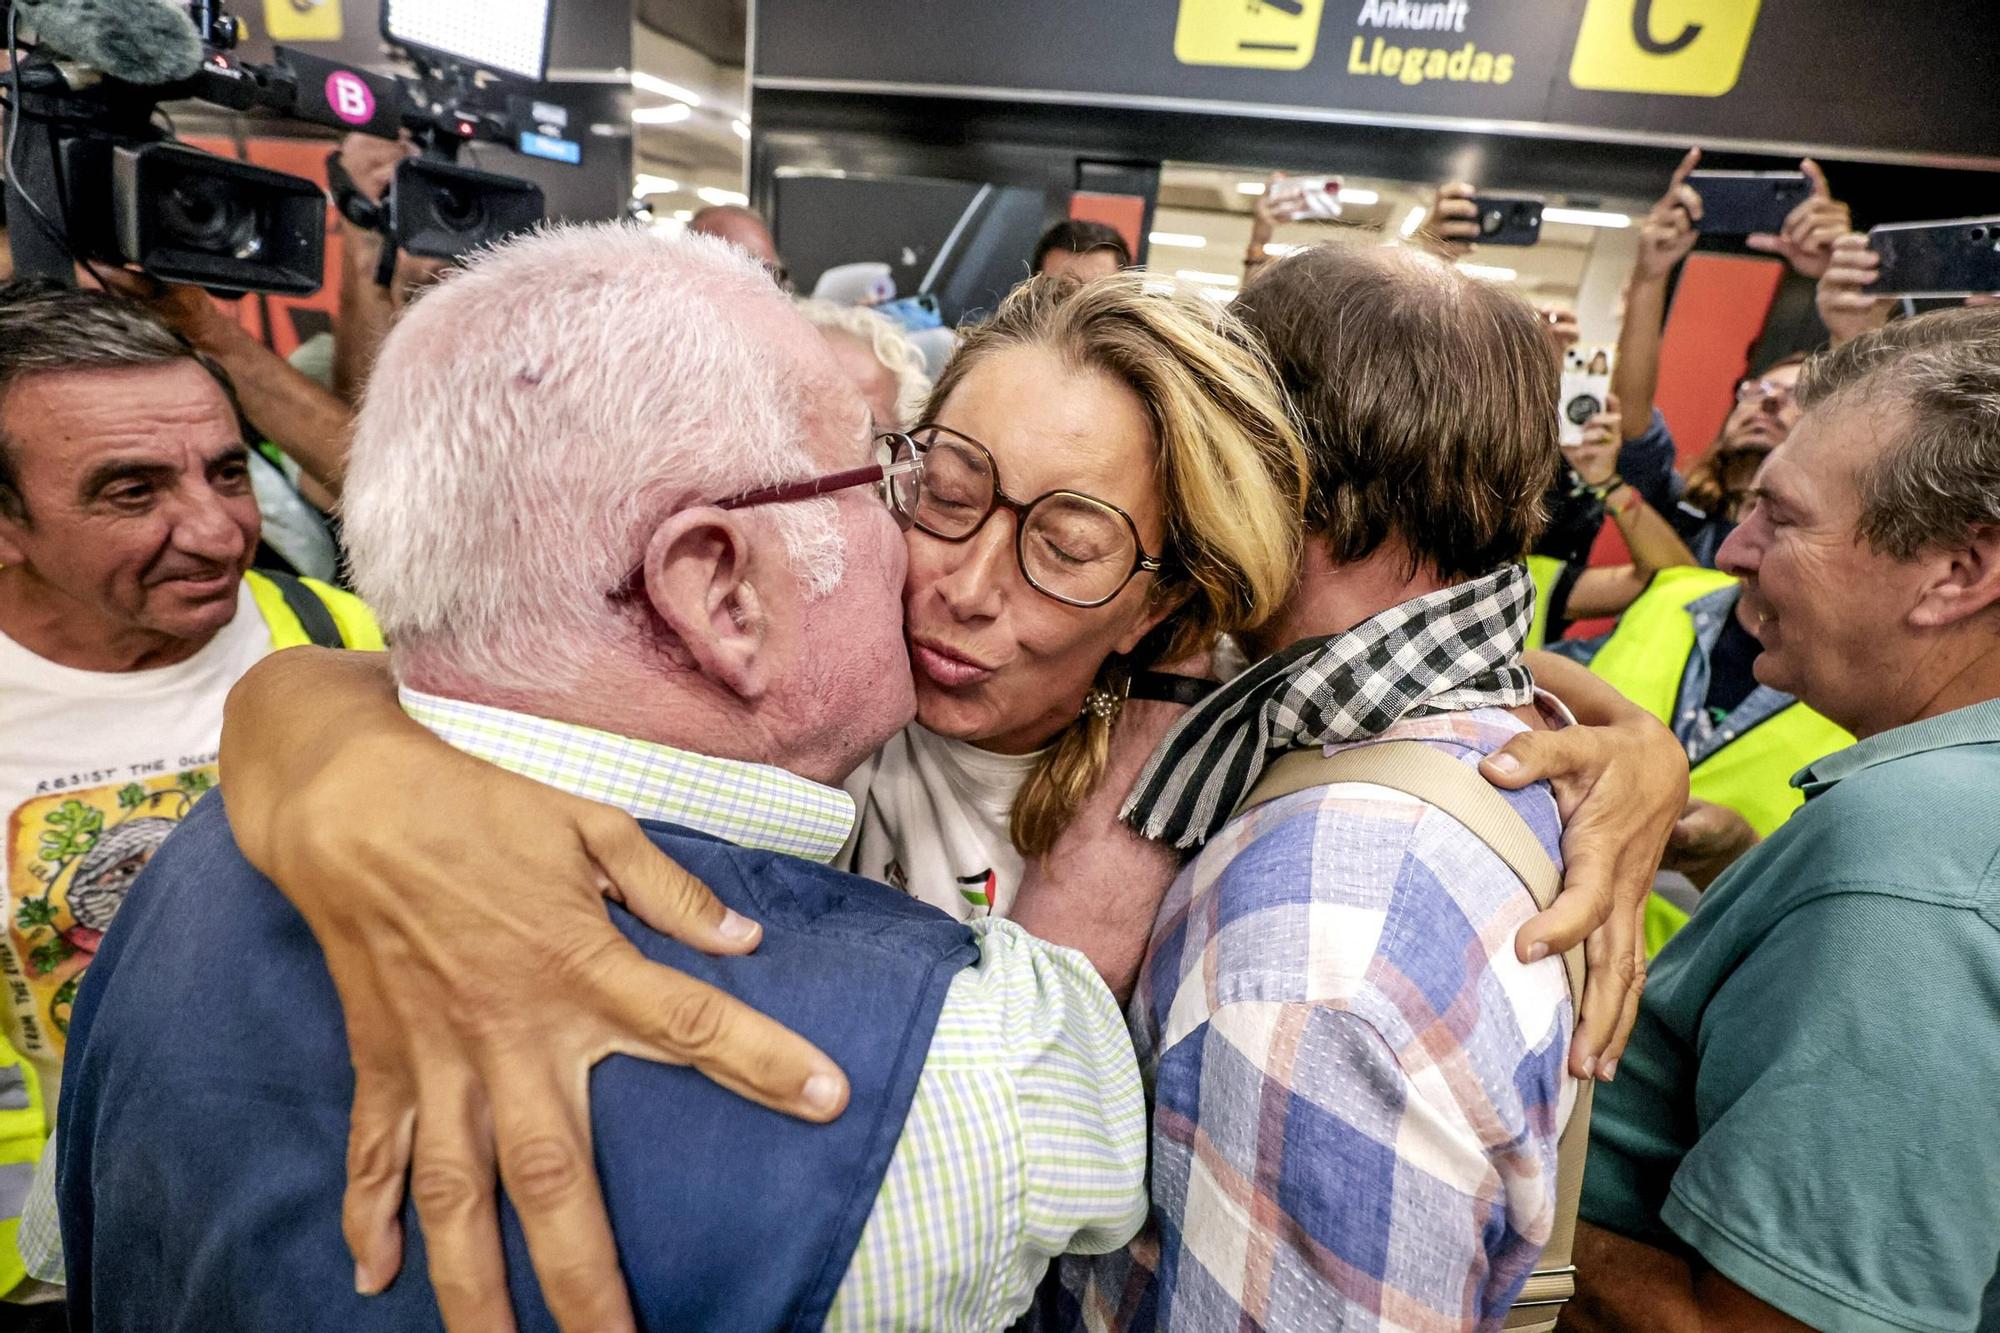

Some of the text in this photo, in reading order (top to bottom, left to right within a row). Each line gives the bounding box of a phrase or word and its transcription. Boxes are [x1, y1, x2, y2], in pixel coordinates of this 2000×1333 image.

[1357, 0, 1469, 32] Ankunft
[1347, 36, 1515, 85] Llegadas
[336, 77, 367, 117] B
[37, 752, 218, 793] RESIST THE OCCU
[10, 981, 30, 1005] THE
